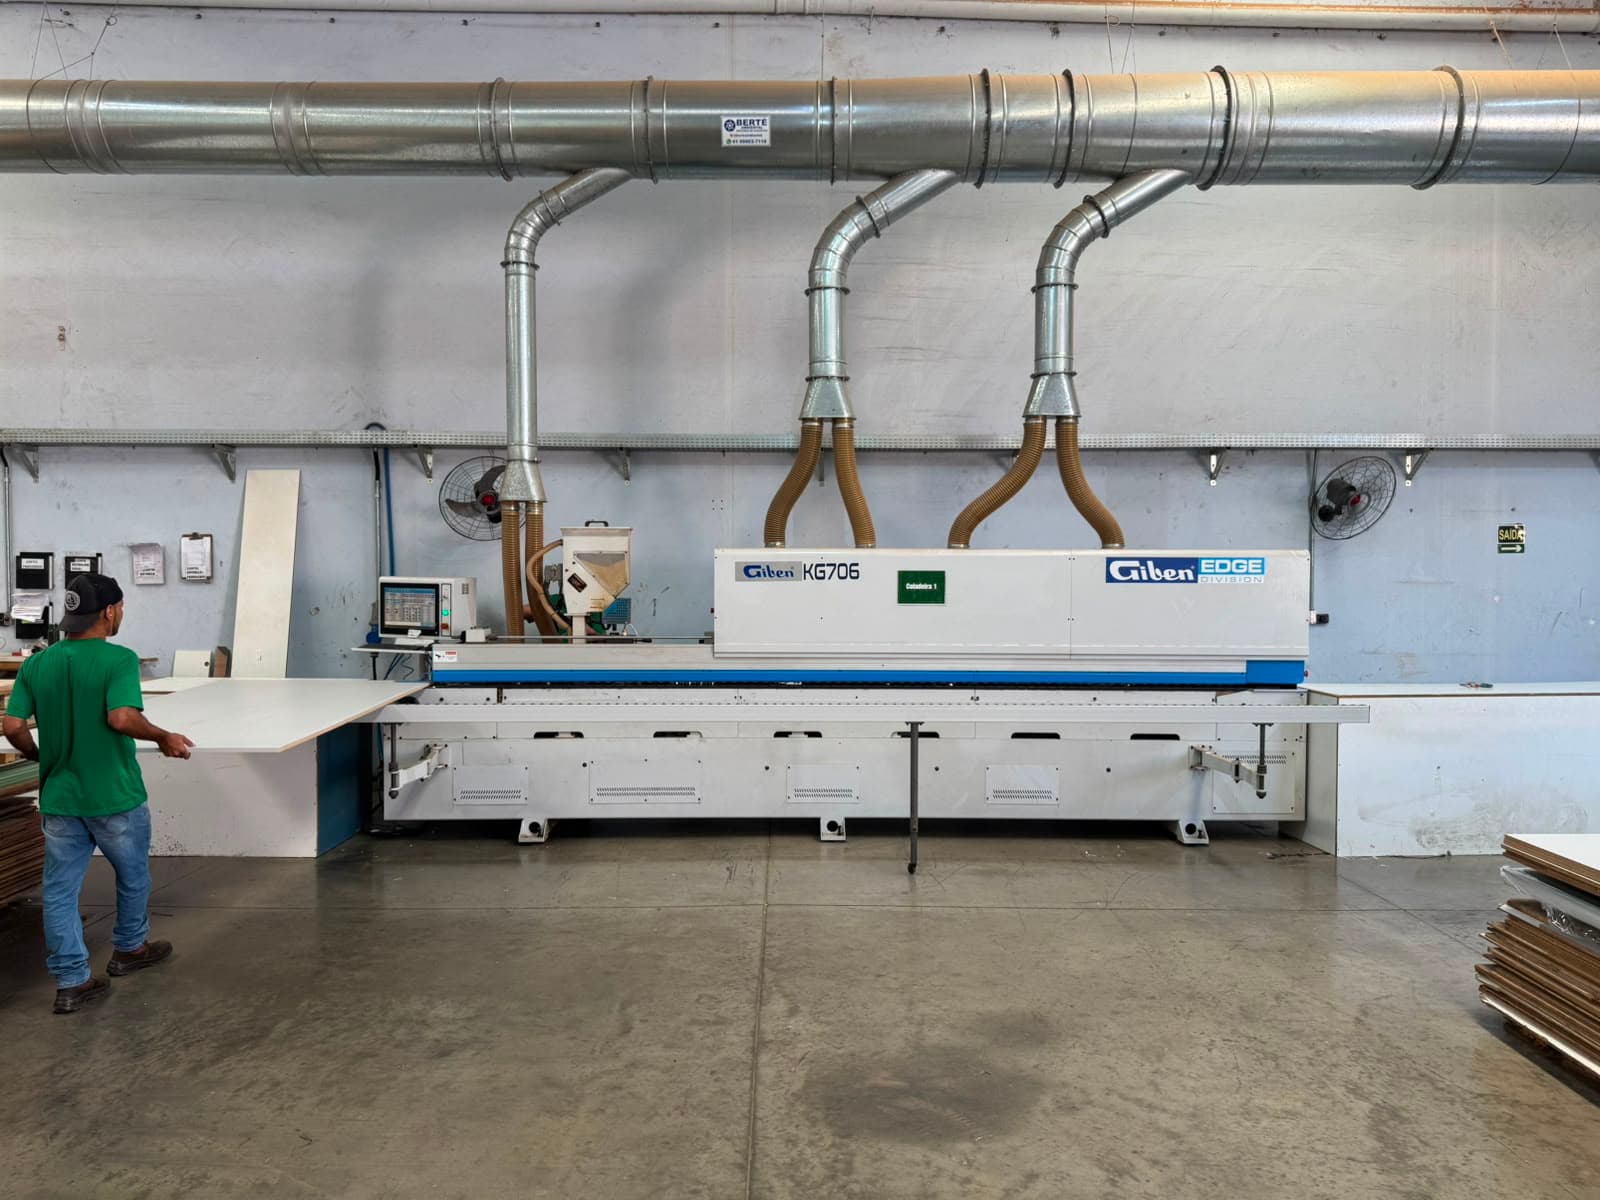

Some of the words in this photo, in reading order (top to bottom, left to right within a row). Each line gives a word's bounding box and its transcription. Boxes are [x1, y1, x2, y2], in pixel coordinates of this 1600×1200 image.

[743, 565, 795, 578] Giben
[803, 563, 860, 580] KG706
[1109, 560, 1195, 581] Giben
[1201, 559, 1262, 573] EDGE
